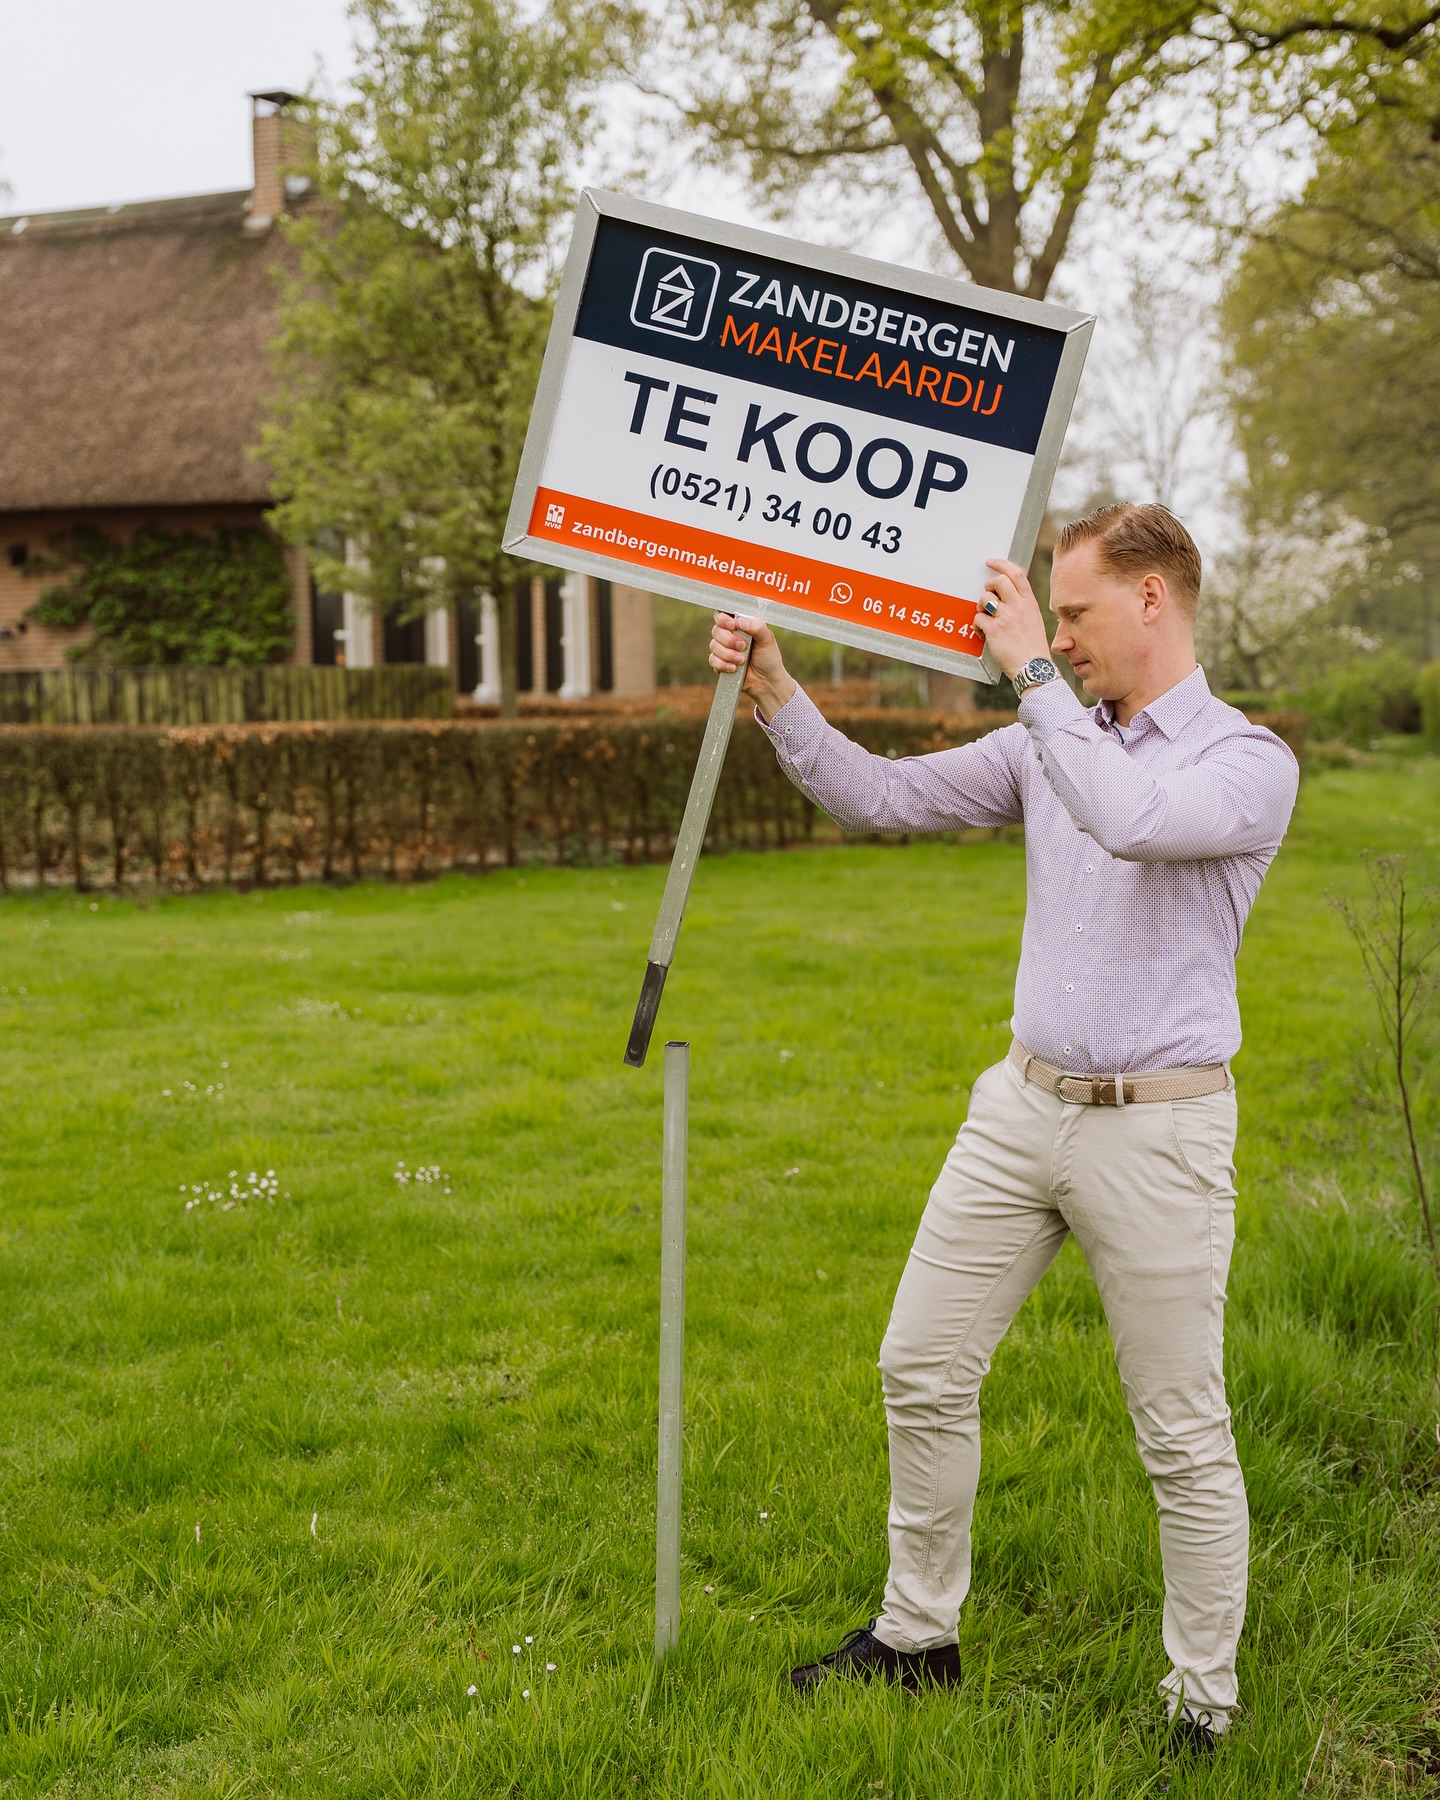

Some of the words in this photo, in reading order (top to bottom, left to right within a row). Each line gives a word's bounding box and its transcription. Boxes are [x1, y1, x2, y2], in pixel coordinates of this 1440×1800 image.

[720, 314, 1003, 416] MAKELAARDIJ
[728, 270, 1016, 373] ZANDBERGEN
[624, 371, 719, 452] TE
[736, 403, 969, 511] KOOP
[544, 520, 562, 530] NVM
[649, 463, 752, 523] (0521)
[762, 494, 802, 528] 34
[812, 507, 852, 541] 00
[861, 521, 903, 555] 43
[571, 521, 811, 595] zandbergenmakelaardij.nl
[862, 597, 883, 614] 06
[888, 604, 907, 621] 14
[910, 610, 931, 627] 55
[934, 617, 955, 633] 45
